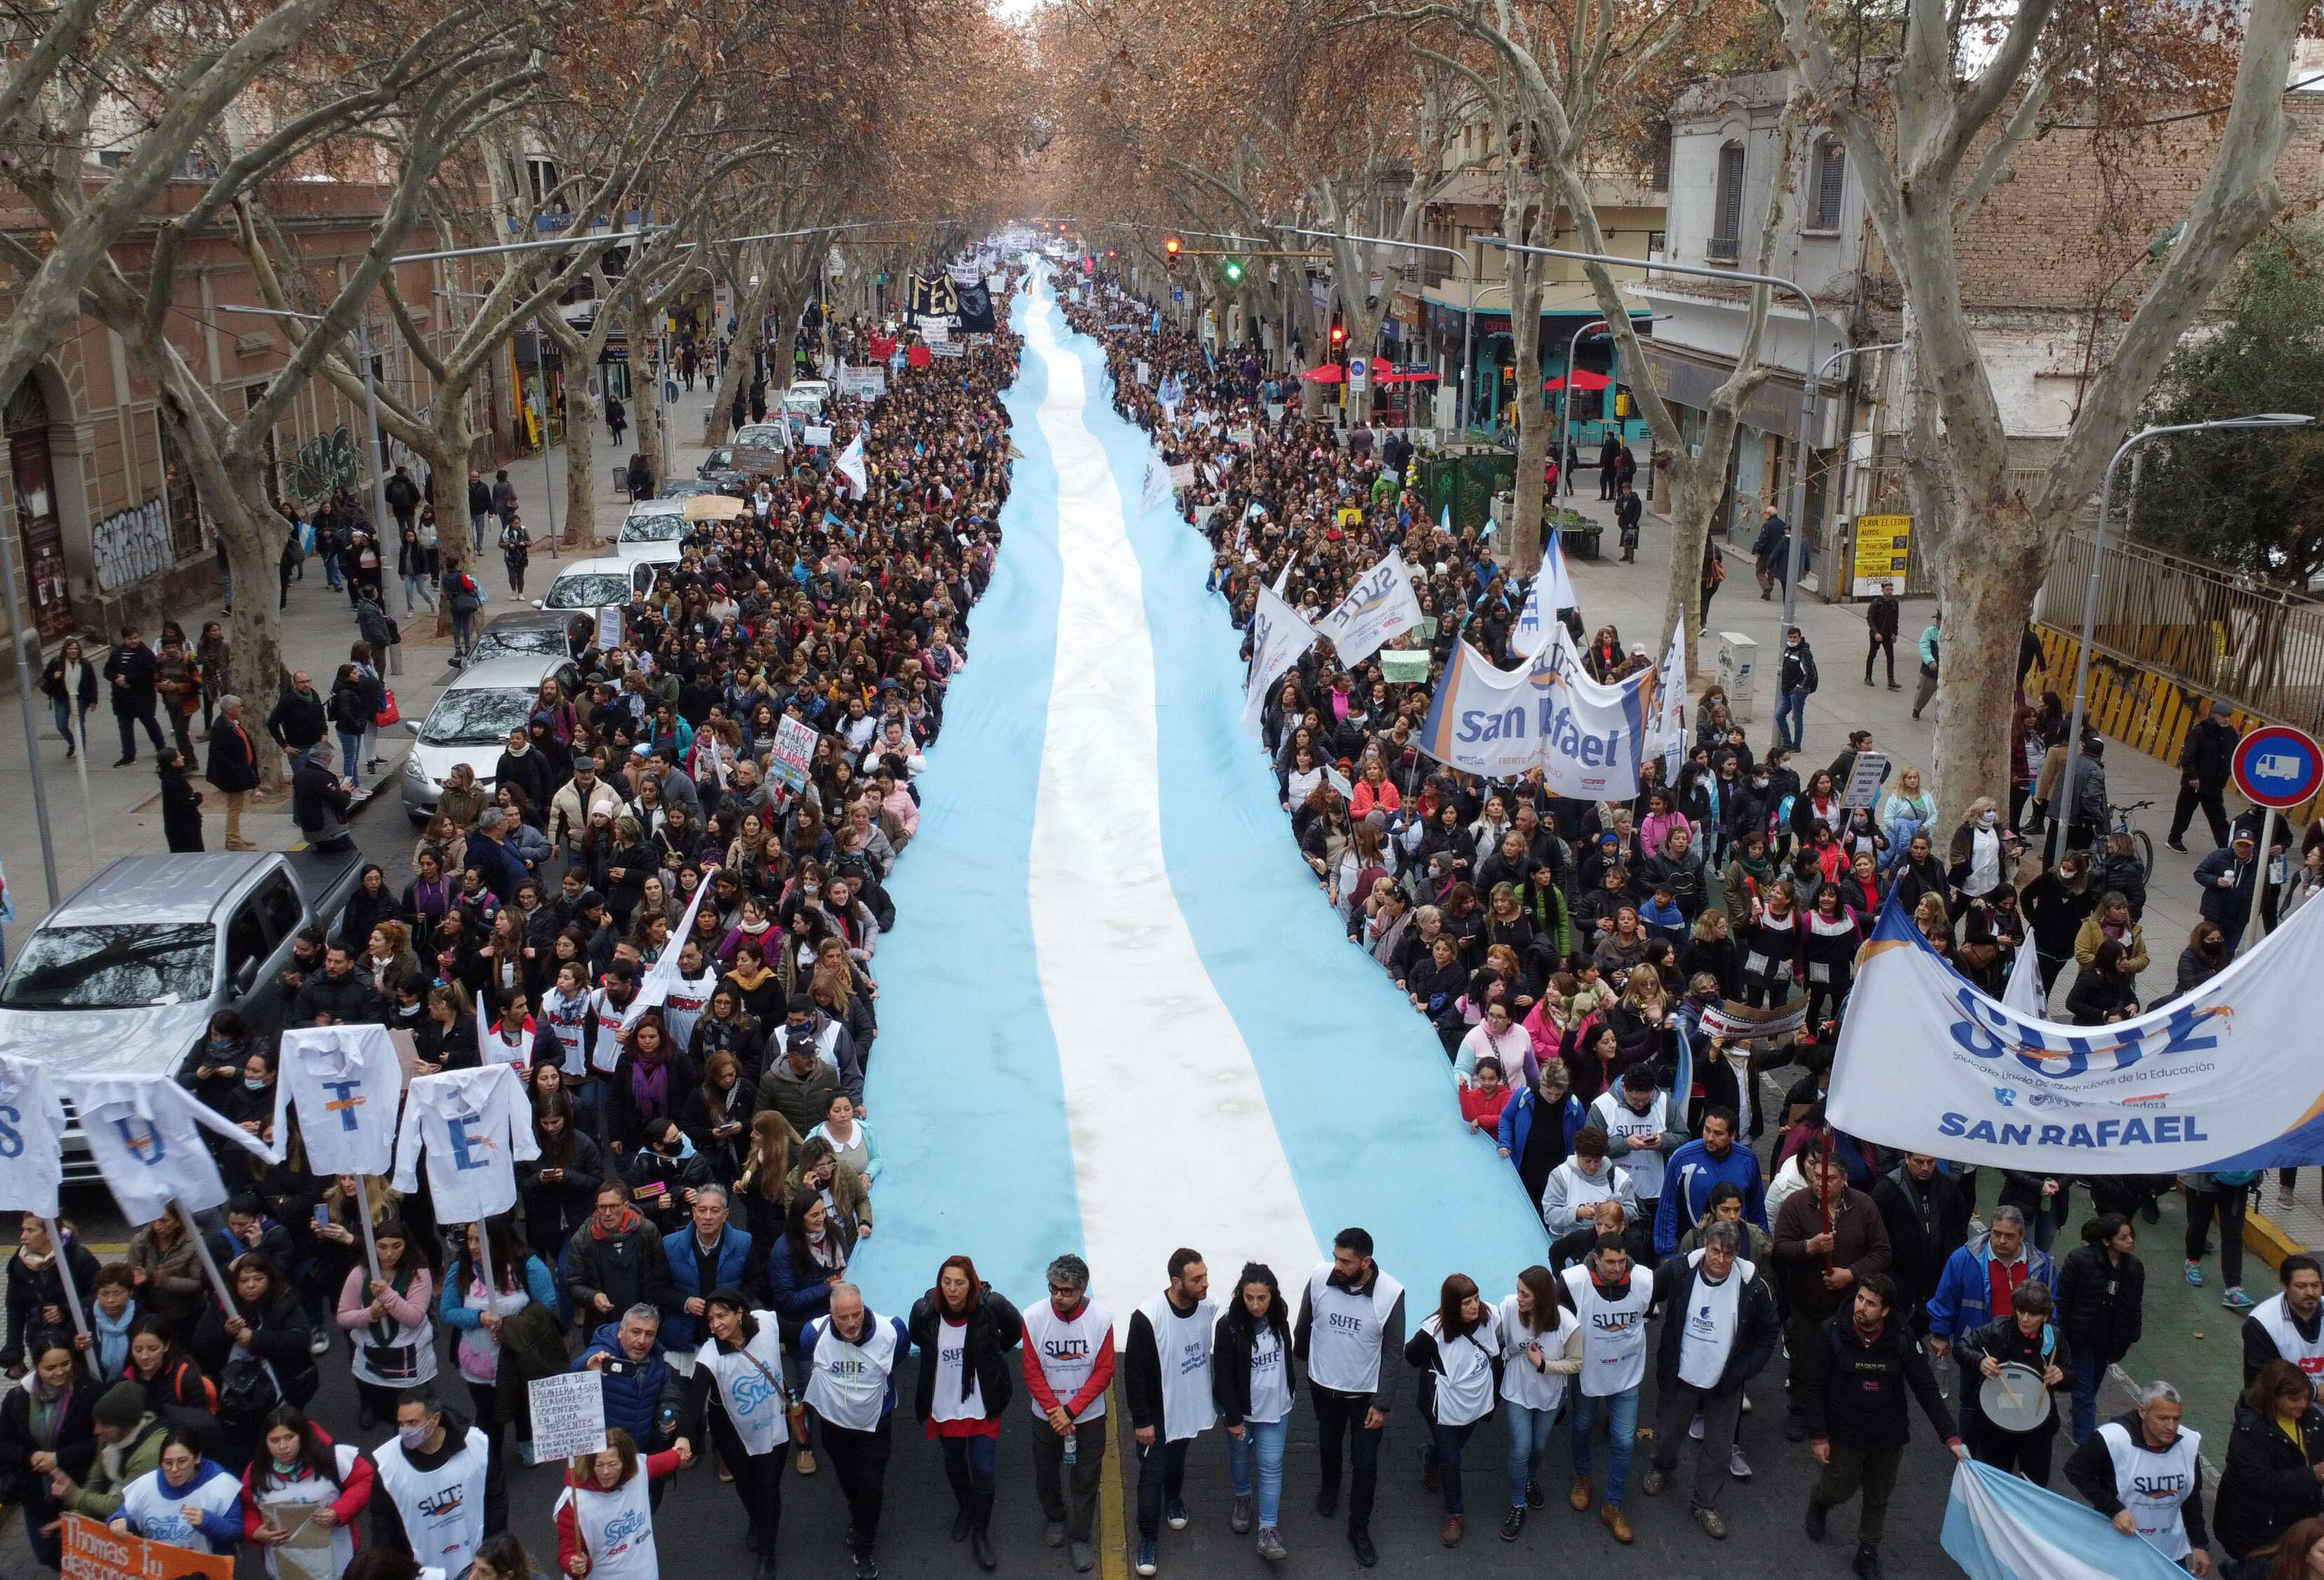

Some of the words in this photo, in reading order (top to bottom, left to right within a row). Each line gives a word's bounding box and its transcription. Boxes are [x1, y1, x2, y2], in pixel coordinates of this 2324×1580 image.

[1859, 519, 1879, 527] PLAYA
[1861, 529, 1882, 537] AUTOS:
[793, 723, 814, 743] MZA
[771, 743, 810, 772] SALARIOS
[779, 738, 808, 759] AJUSTE
[2002, 1070, 2033, 1085] Unido
[2118, 1074, 2134, 1084] de
[2136, 1070, 2148, 1081] la
[2150, 1061, 2215, 1080] Educación
[322, 1080, 362, 1132] T
[0, 1105, 25, 1159] S
[1616, 1124, 1653, 1137] SUTE
[1937, 1111, 2032, 1146] SAN
[2038, 1115, 2208, 1147] RAFAEL
[113, 1117, 166, 1166] U
[447, 1115, 490, 1171] E
[1328, 1312, 1363, 1331] SUTE
[1592, 1311, 1638, 1328] SUTE
[942, 1347, 965, 1362] SUT
[1045, 1339, 1090, 1357] SUTE
[1184, 1341, 1202, 1355] SUTE
[831, 1360, 866, 1374] SUTE
[1250, 1351, 1281, 1369] SUTE
[531, 1376, 568, 1390] ESCUELA
[574, 1374, 587, 1383] DE
[535, 1404, 581, 1416] DOCENTES
[554, 1413, 579, 1423] LUCHA
[545, 1418, 594, 1432] PRESENTES
[2134, 1474, 2185, 1494] SUTE
[67, 1517, 129, 1567] Thomas
